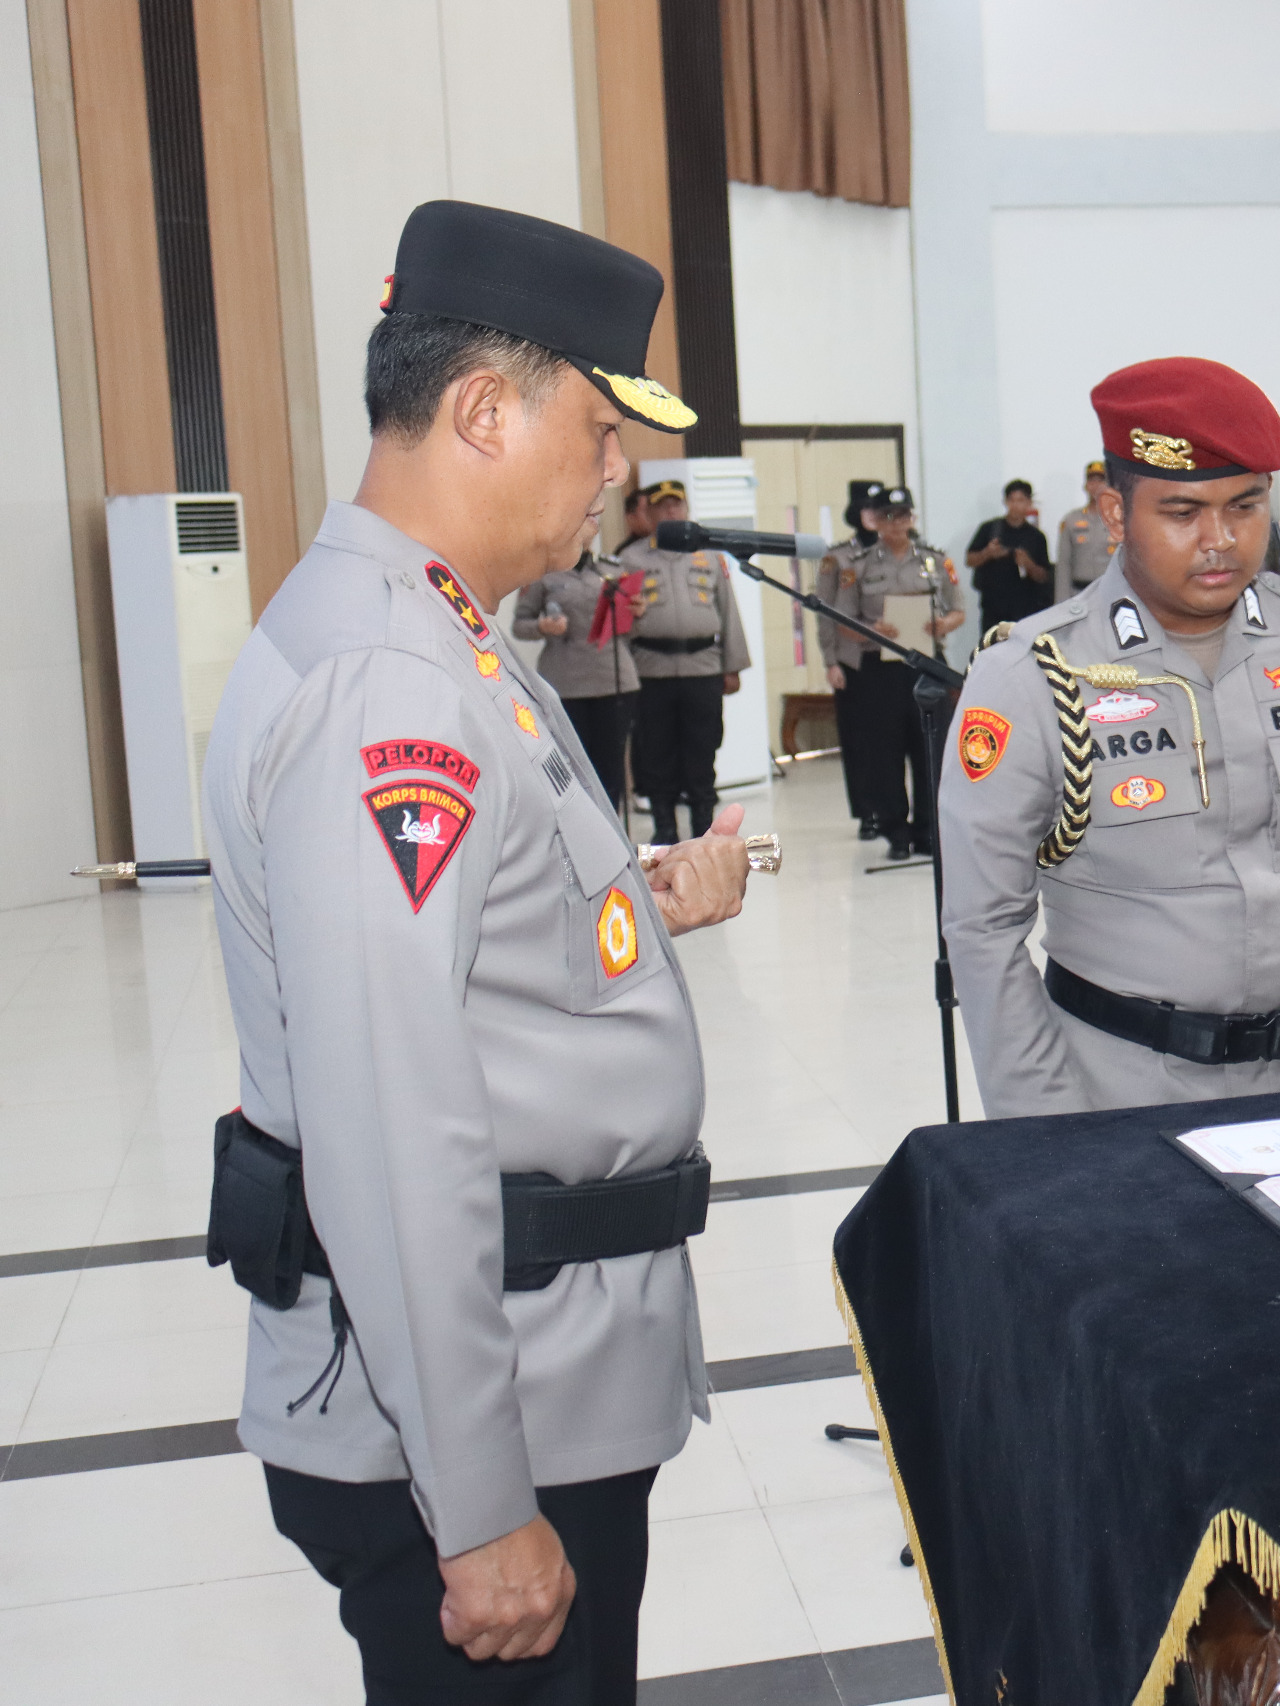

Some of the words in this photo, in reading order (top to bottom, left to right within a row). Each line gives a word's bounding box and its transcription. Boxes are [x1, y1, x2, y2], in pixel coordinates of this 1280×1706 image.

[369, 745, 473, 785] PELOPOR
[372, 788, 417, 811] KORPS
[420, 788, 466, 819] BRIMOB
